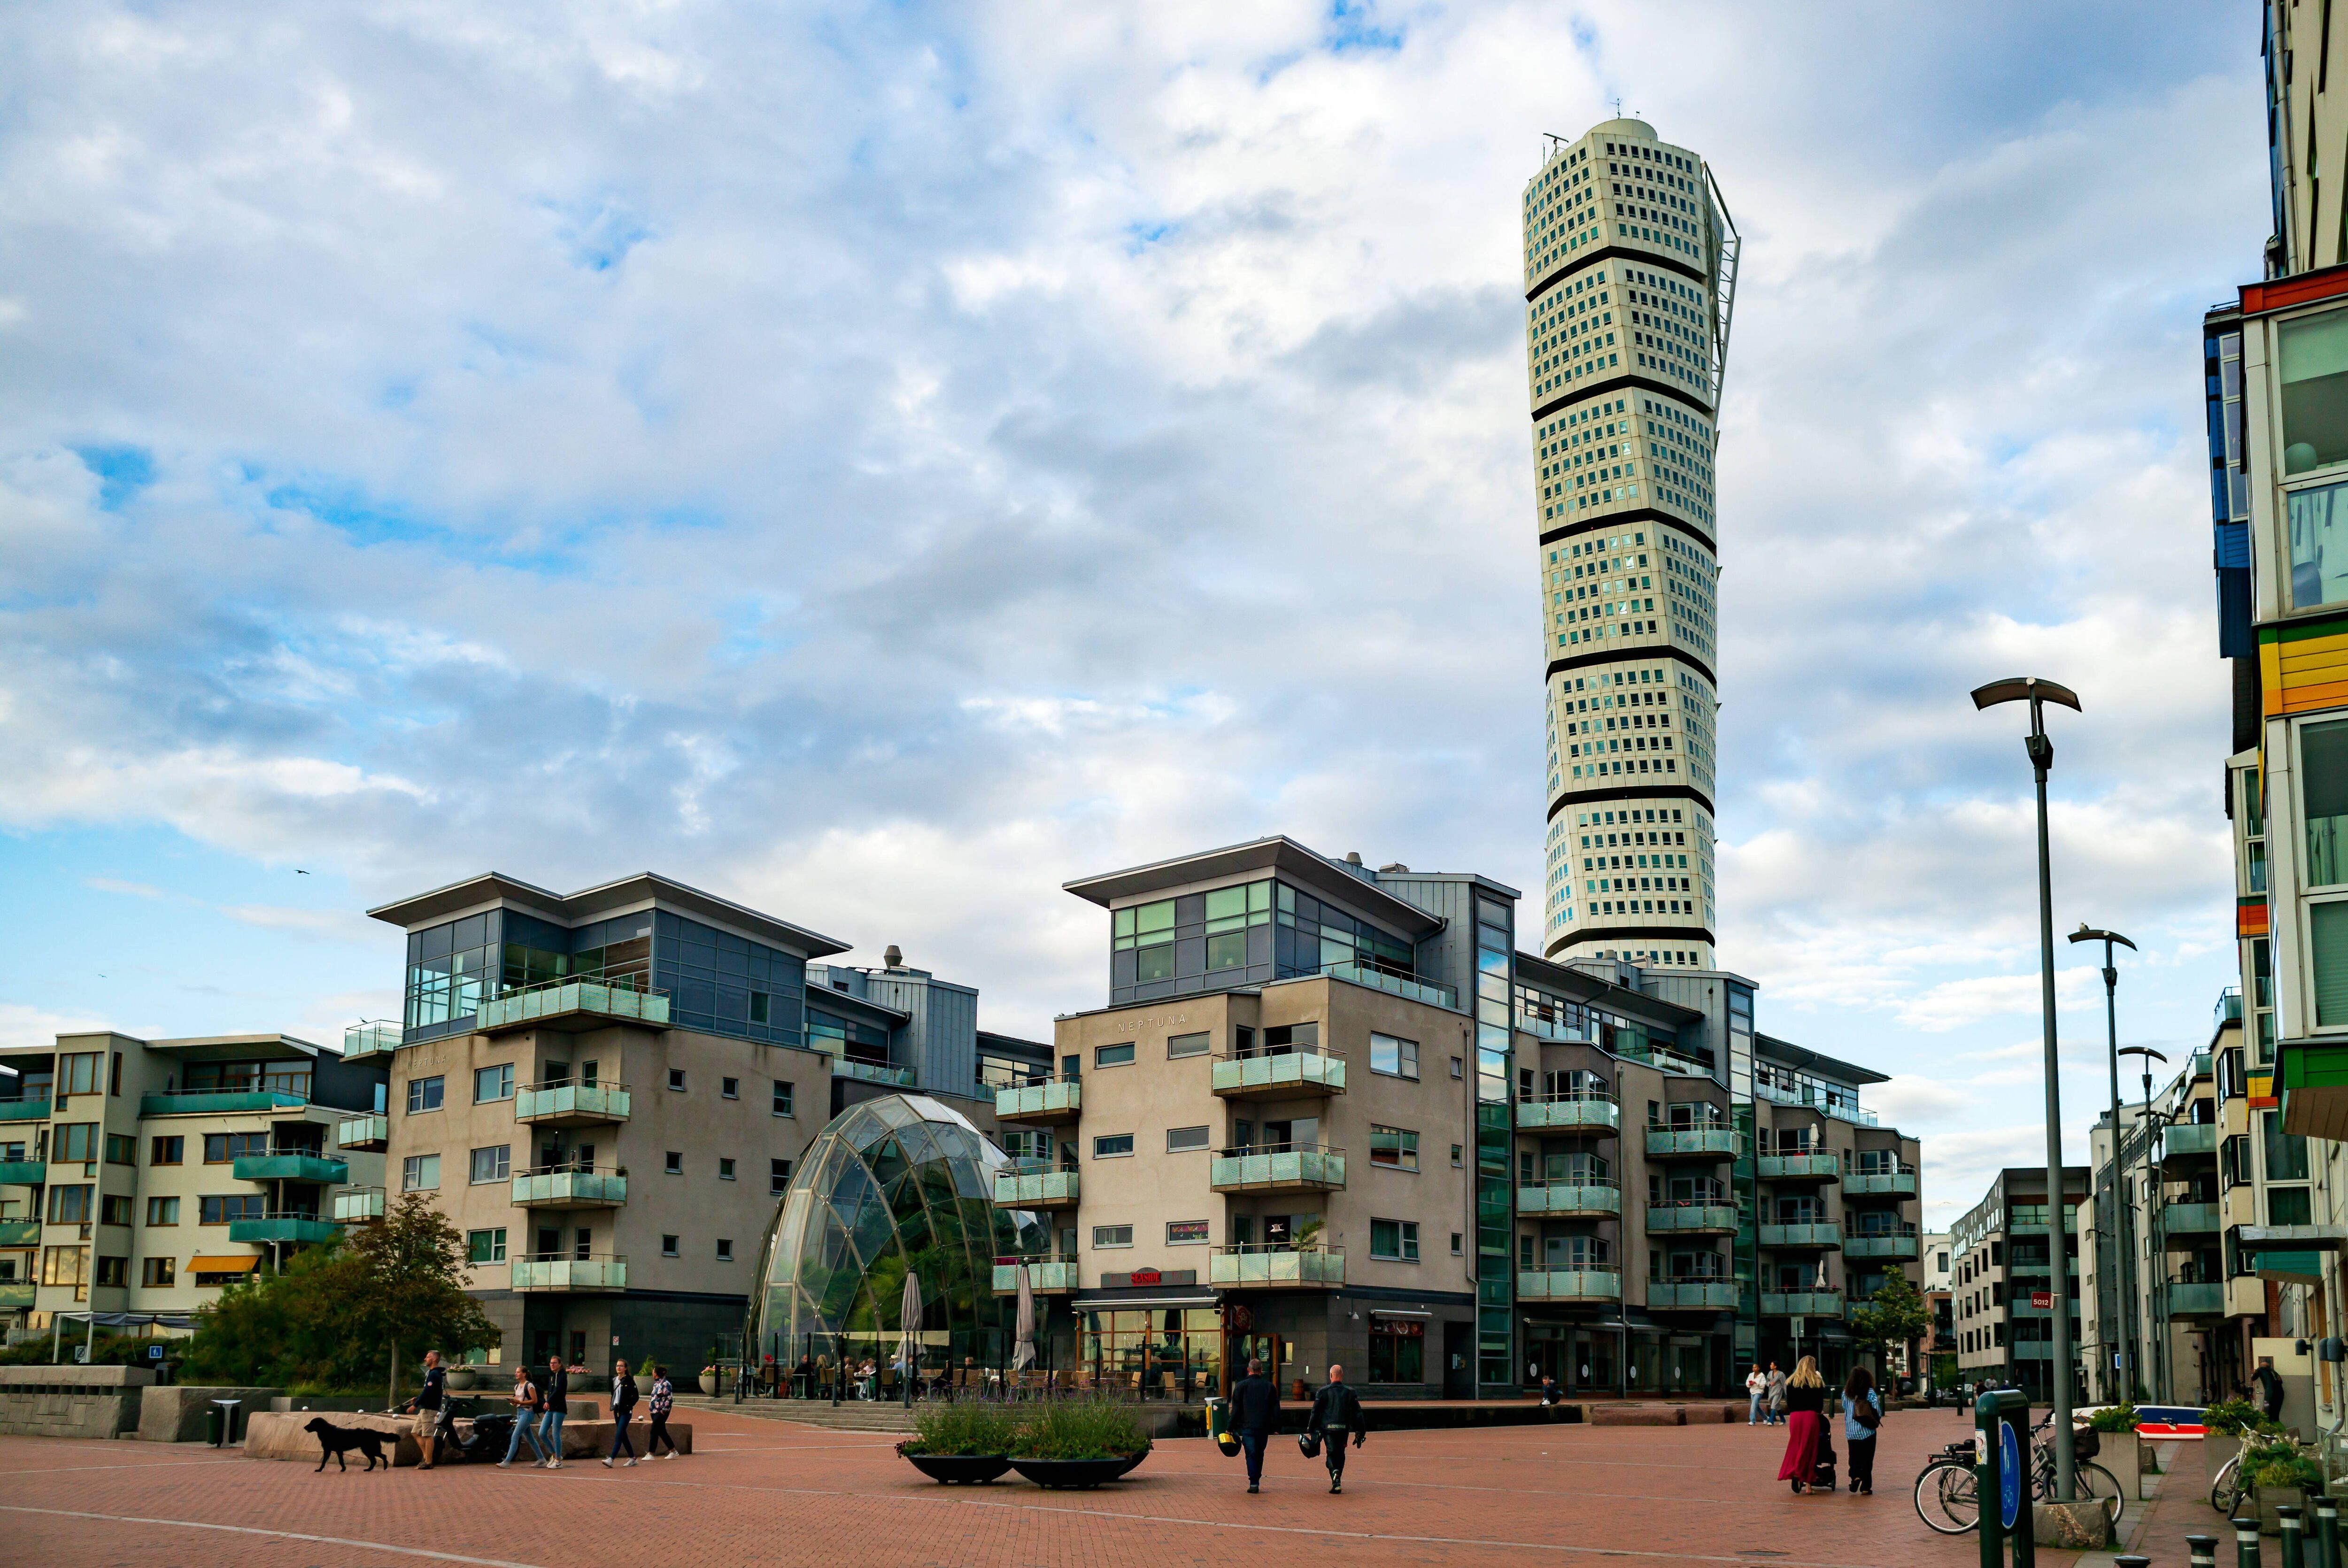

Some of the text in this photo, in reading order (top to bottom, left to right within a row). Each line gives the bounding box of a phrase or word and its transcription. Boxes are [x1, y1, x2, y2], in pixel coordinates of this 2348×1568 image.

[1118, 1014, 1186, 1032] NEPTUNA
[408, 1054, 447, 1070] NEPTUNA
[1131, 1272, 1161, 1283] SEASIDE
